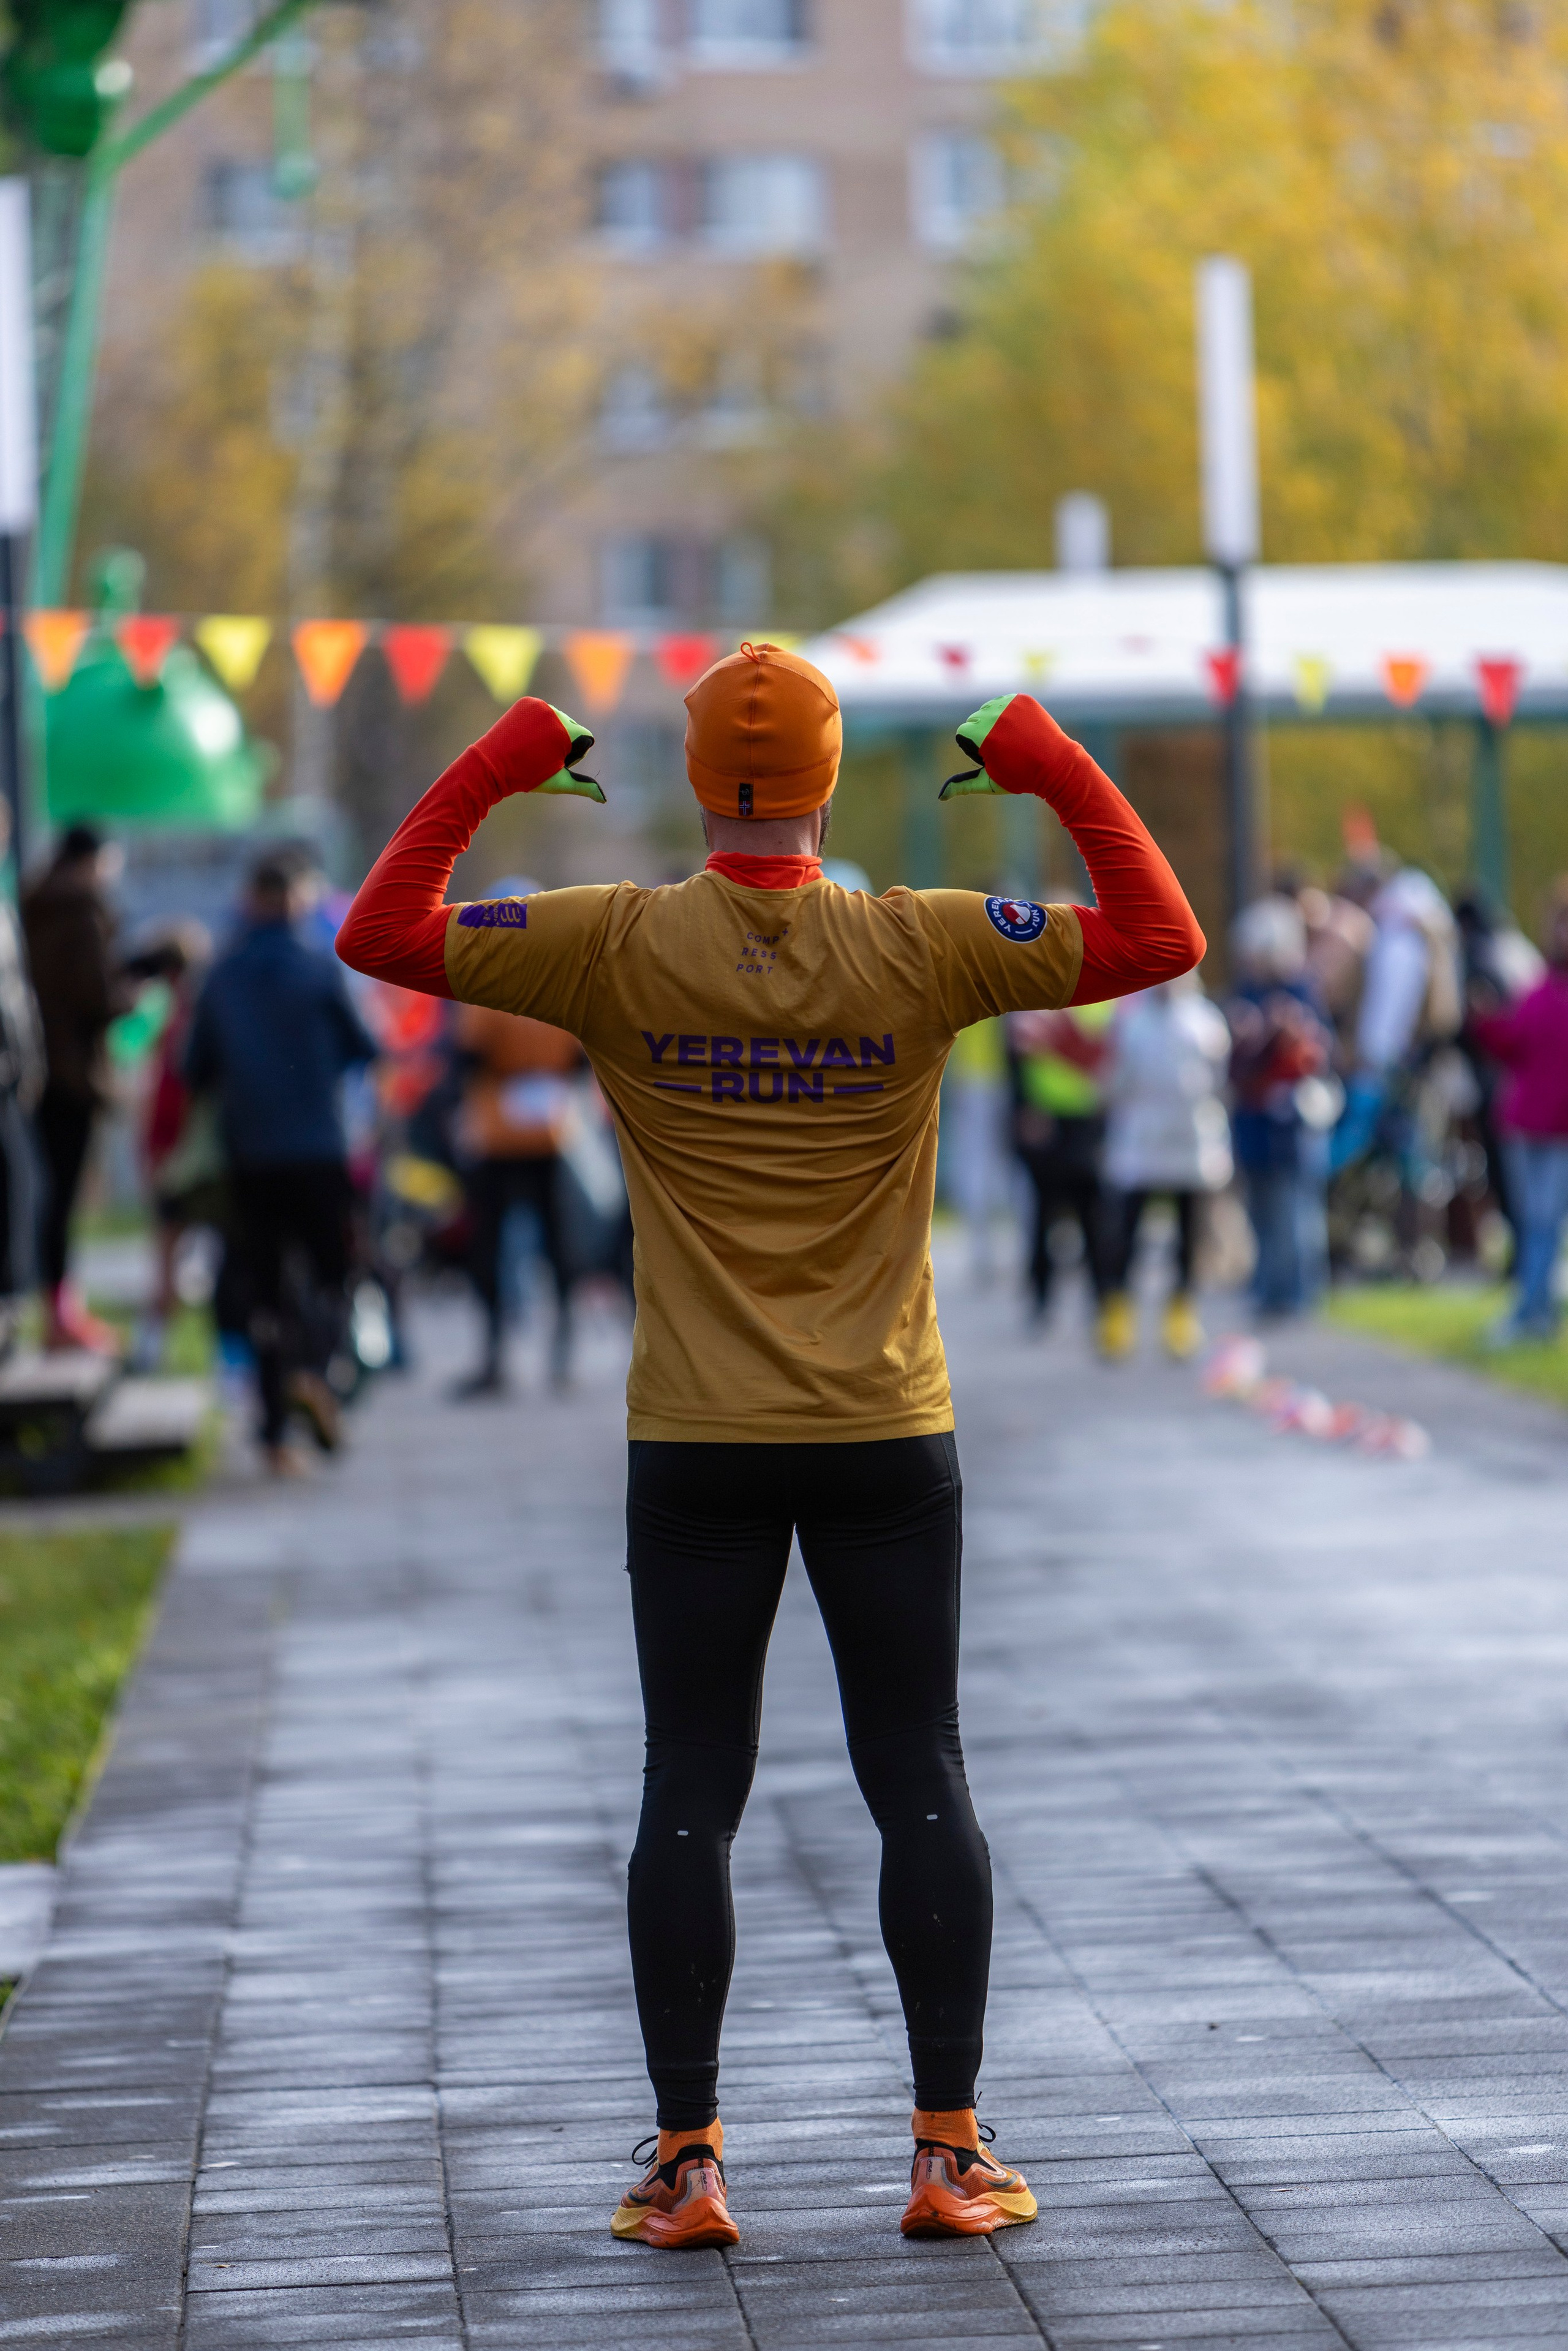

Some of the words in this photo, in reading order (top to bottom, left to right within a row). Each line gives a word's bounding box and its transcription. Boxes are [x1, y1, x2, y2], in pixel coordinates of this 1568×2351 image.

[742, 948, 777, 959] RESS
[736, 964, 773, 974] PORT
[641, 1030, 895, 1068] YEREVAN
[711, 1071, 824, 1103] RUN
